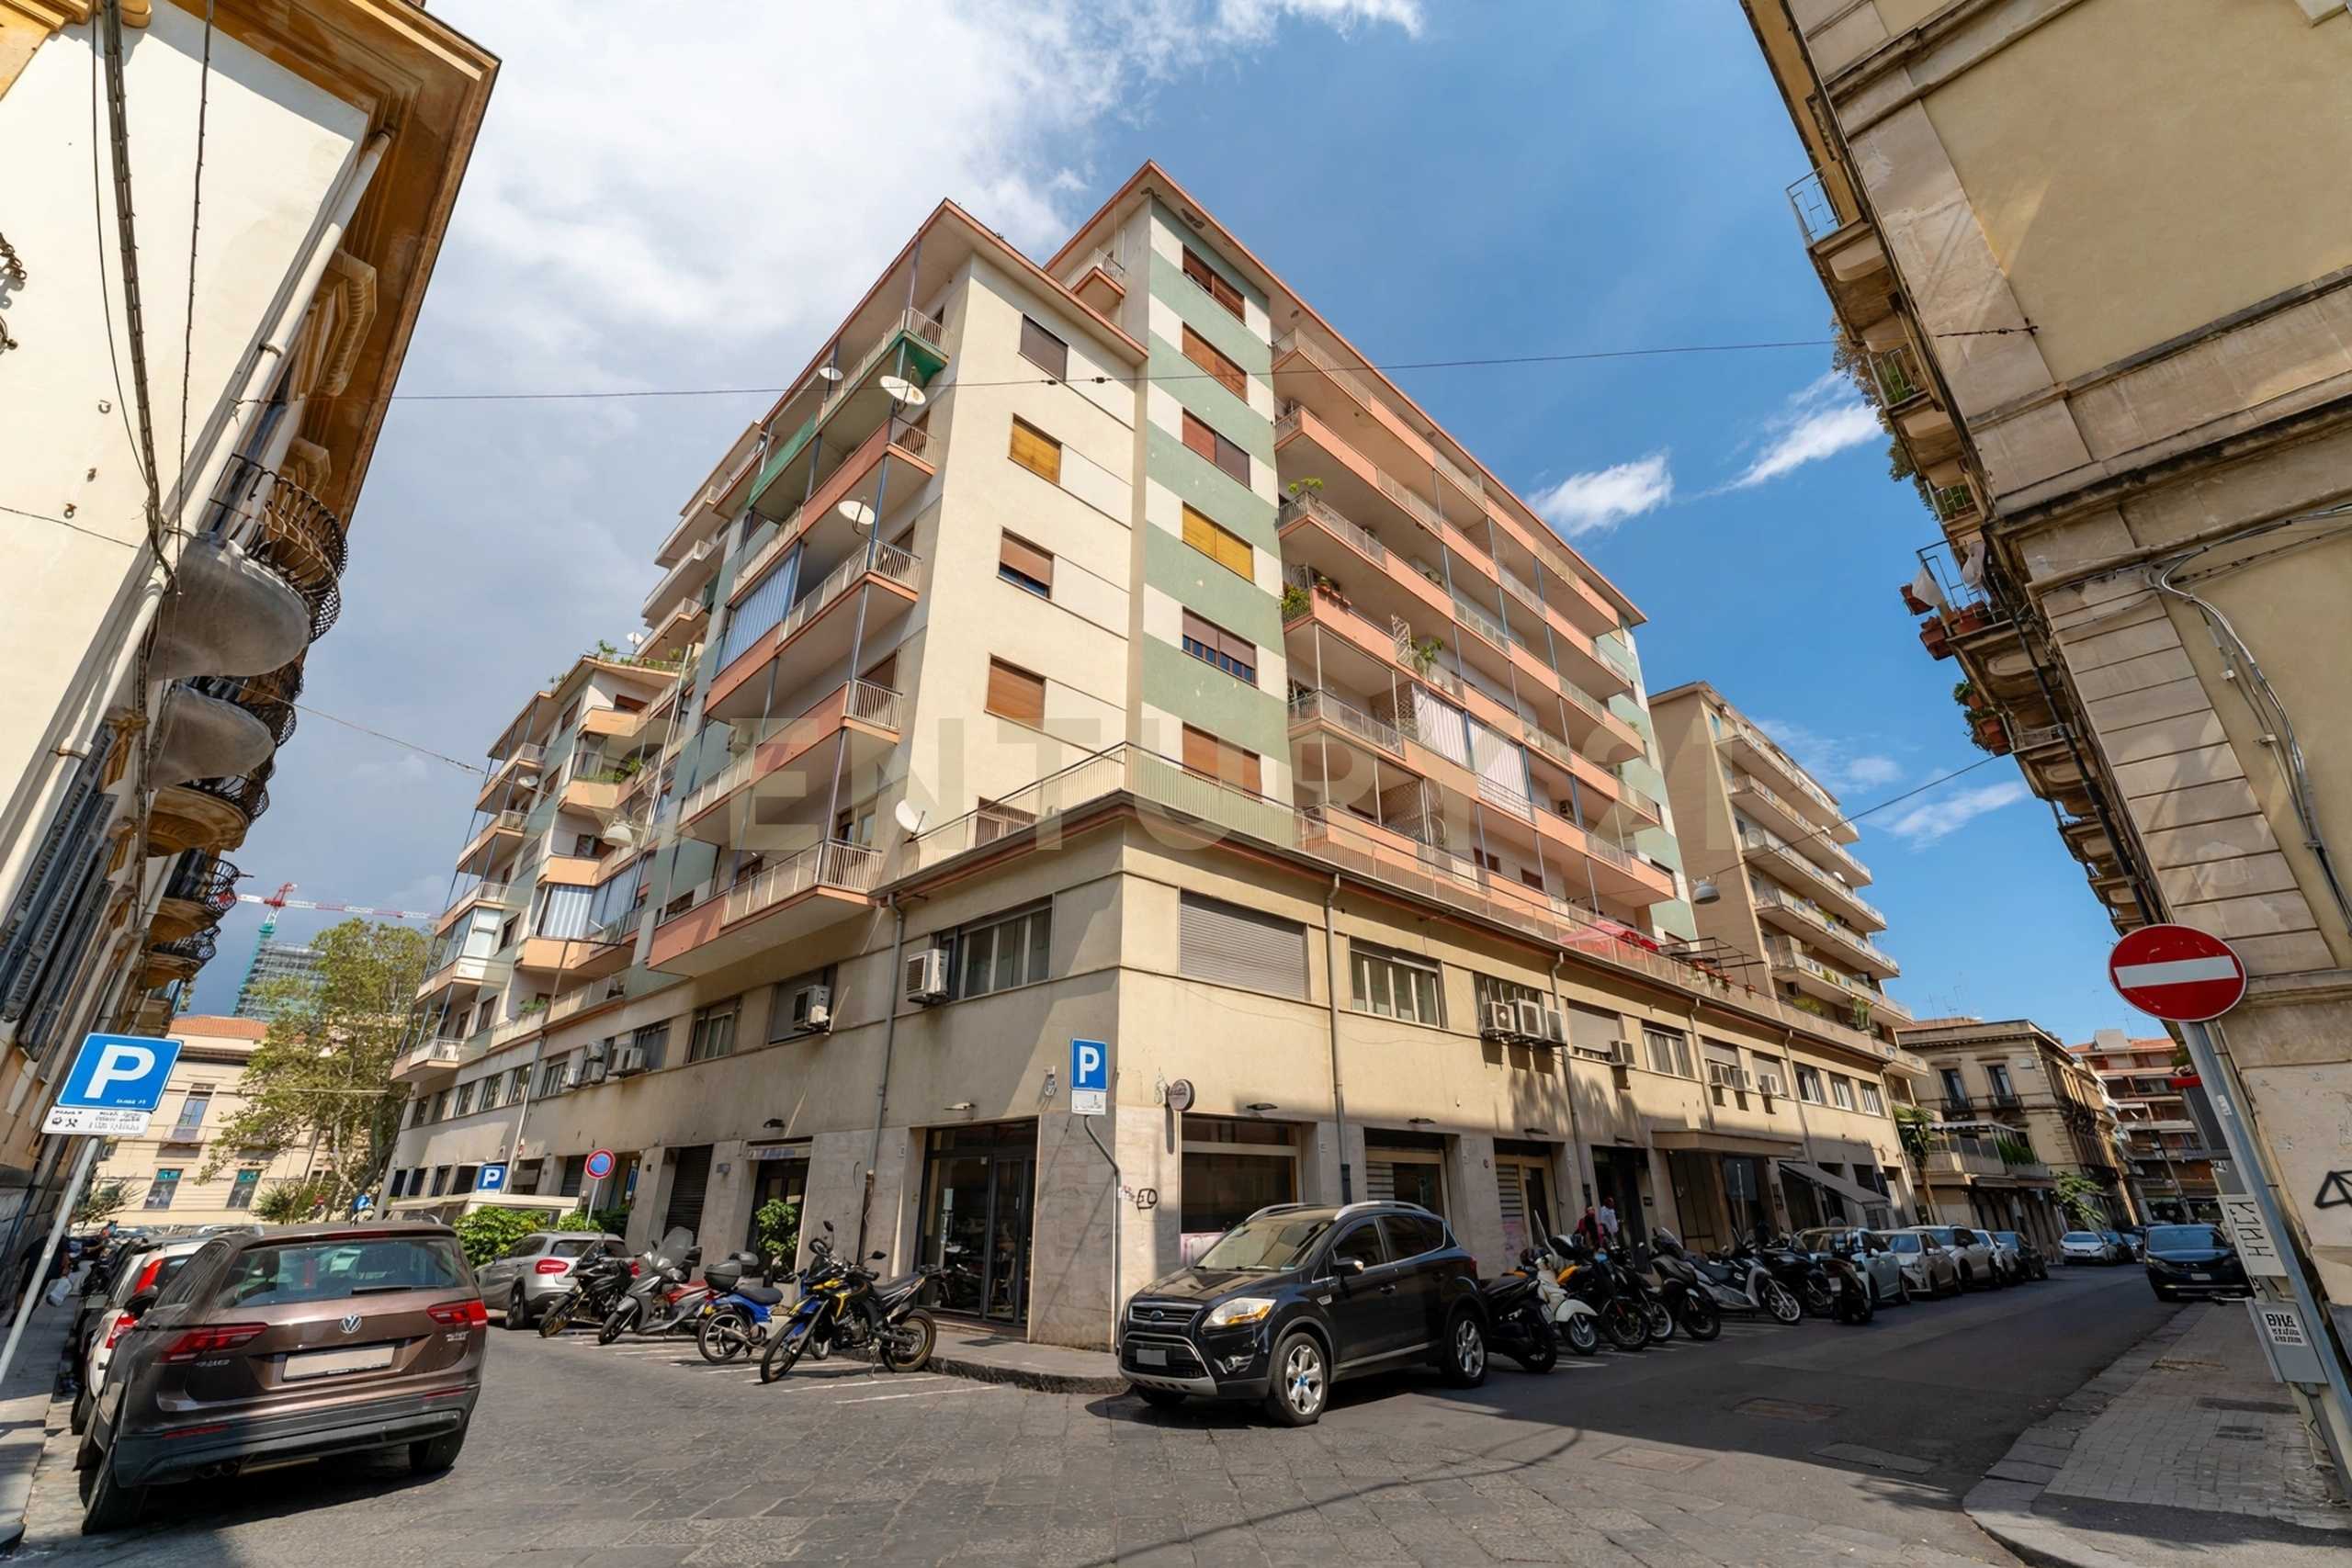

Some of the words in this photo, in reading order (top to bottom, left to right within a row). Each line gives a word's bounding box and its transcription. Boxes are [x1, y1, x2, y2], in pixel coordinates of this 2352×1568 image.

[84, 1043, 155, 1099] P
[1079, 1045, 1100, 1084] P
[482, 1168, 501, 1187] P
